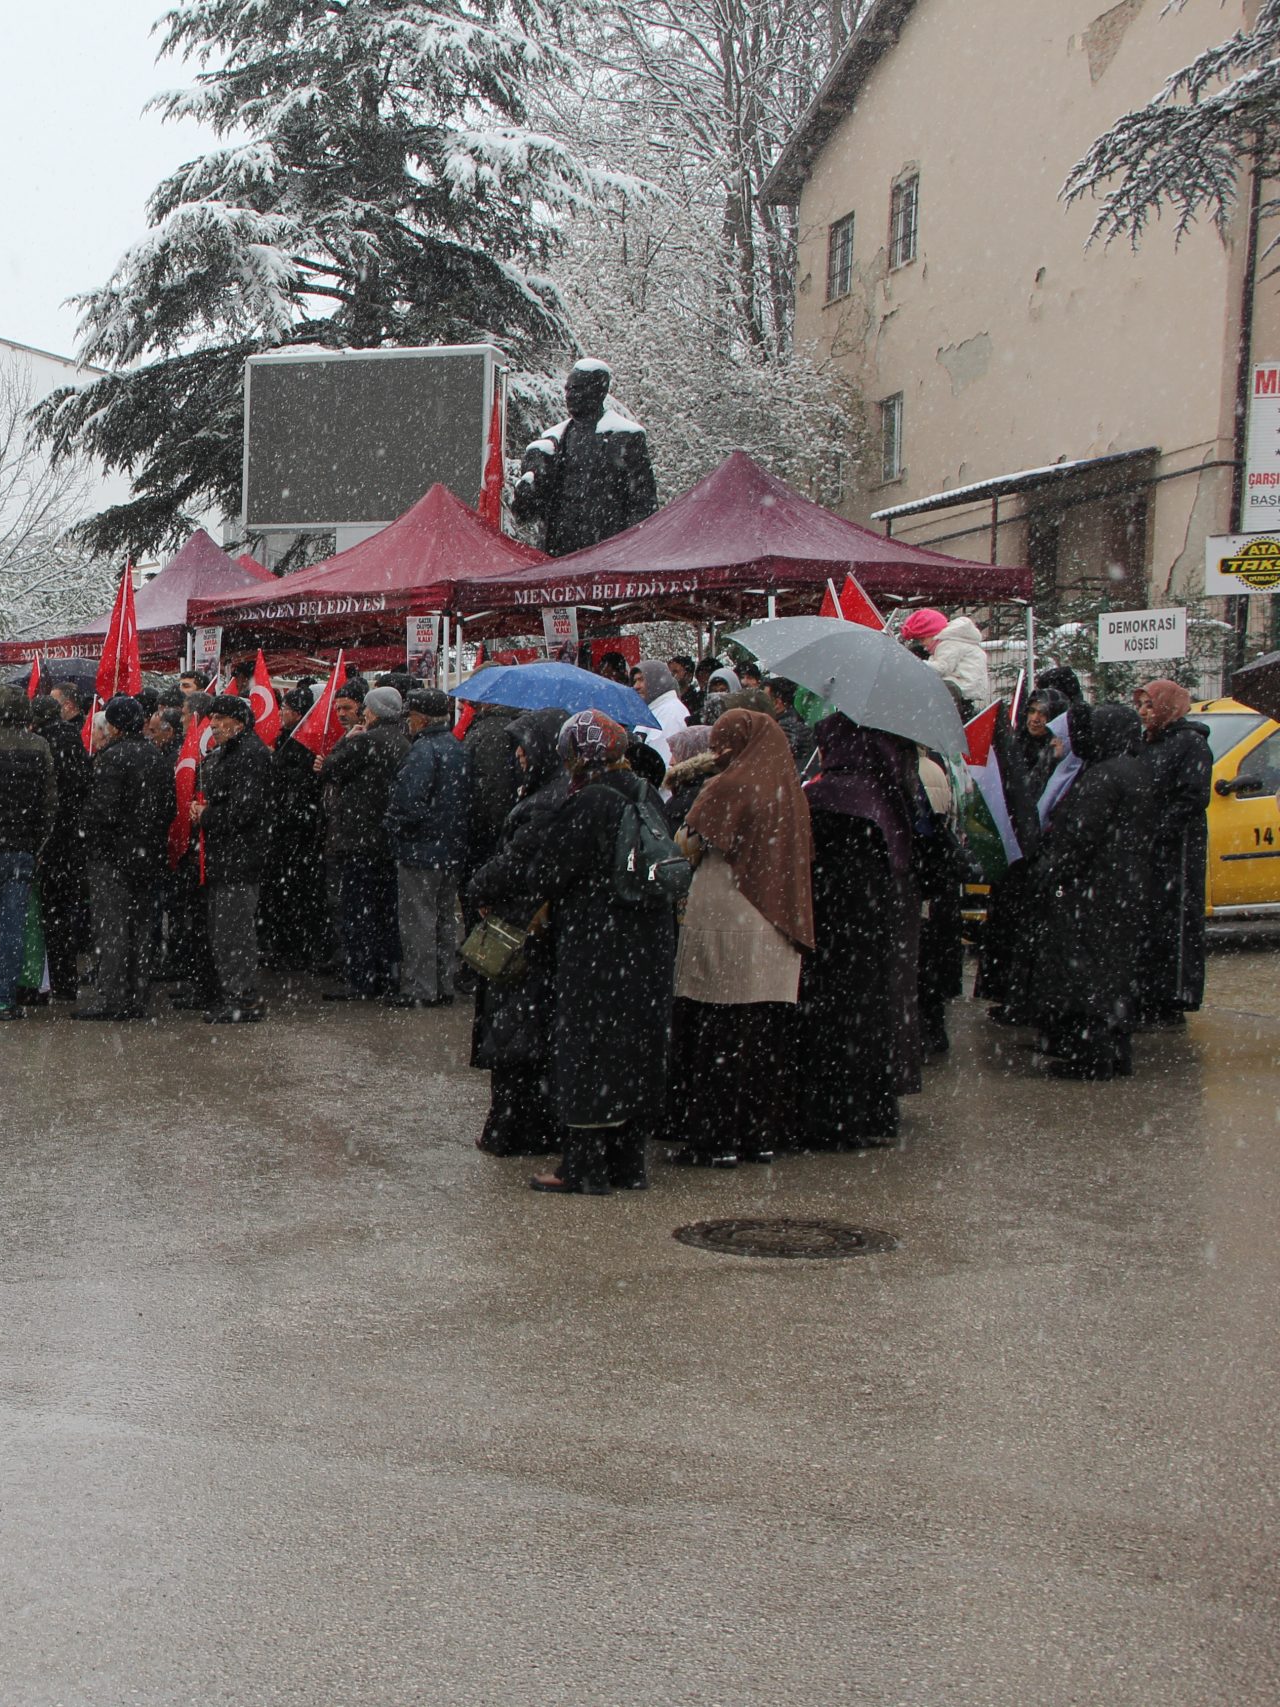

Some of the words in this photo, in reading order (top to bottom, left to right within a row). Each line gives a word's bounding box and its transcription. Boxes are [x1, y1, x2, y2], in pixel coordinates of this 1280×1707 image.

[1248, 544, 1279, 556] ATA
[299, 593, 385, 616] BELEDİYESİ
[514, 586, 587, 605] MENGEN
[1108, 614, 1176, 635] DEMOKRASİ
[1124, 635, 1159, 653] KÖŞESİ
[1254, 827, 1274, 847] 14
